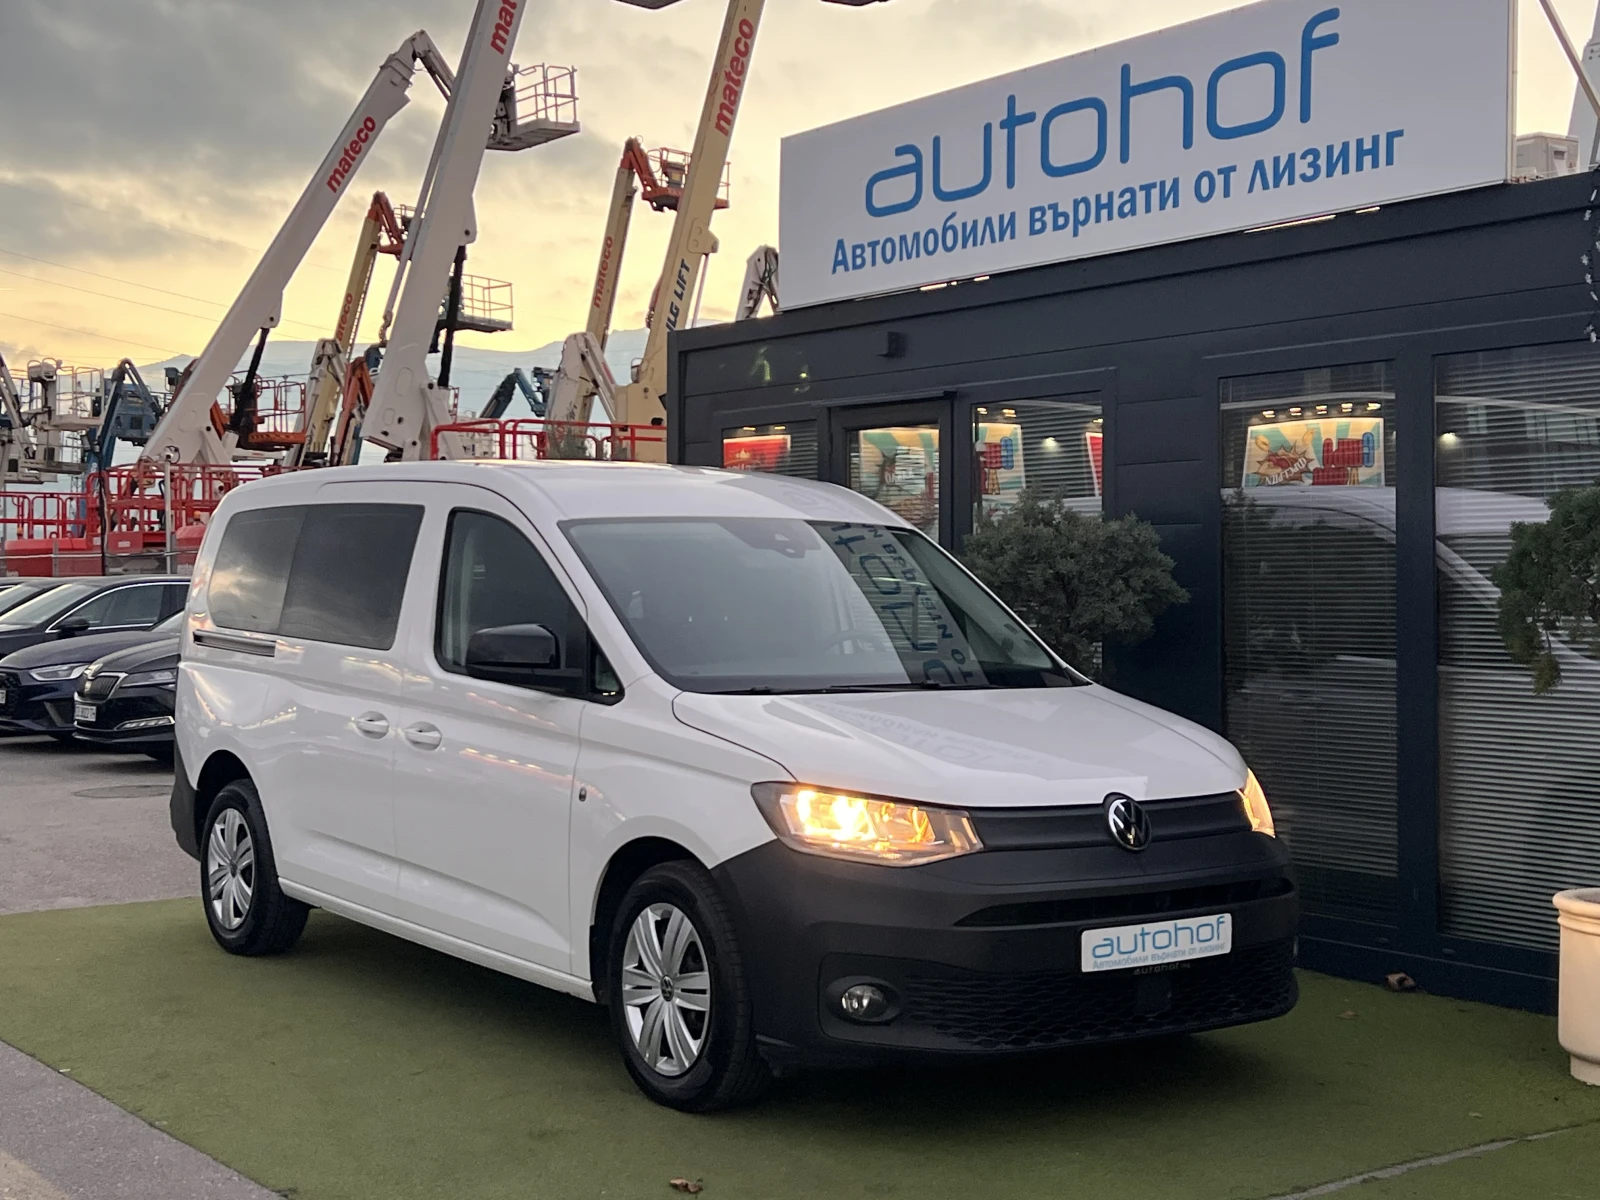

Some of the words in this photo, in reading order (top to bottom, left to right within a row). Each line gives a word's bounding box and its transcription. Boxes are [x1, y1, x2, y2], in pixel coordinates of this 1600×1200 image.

[715, 18, 754, 137] mateco
[865, 7, 1340, 218] autohof
[326, 116, 376, 193] mateco
[831, 211, 1016, 275] Автомобили
[1029, 177, 1180, 238] върнати
[1194, 165, 1237, 203] от
[1247, 128, 1404, 194] лизинг
[593, 235, 613, 309] mateco
[674, 258, 690, 301] LIFT
[336, 292, 353, 342] ateco
[1092, 915, 1226, 959] autohof
[1092, 954, 1150, 970] Автомобили
[1151, 949, 1186, 963] върнати
